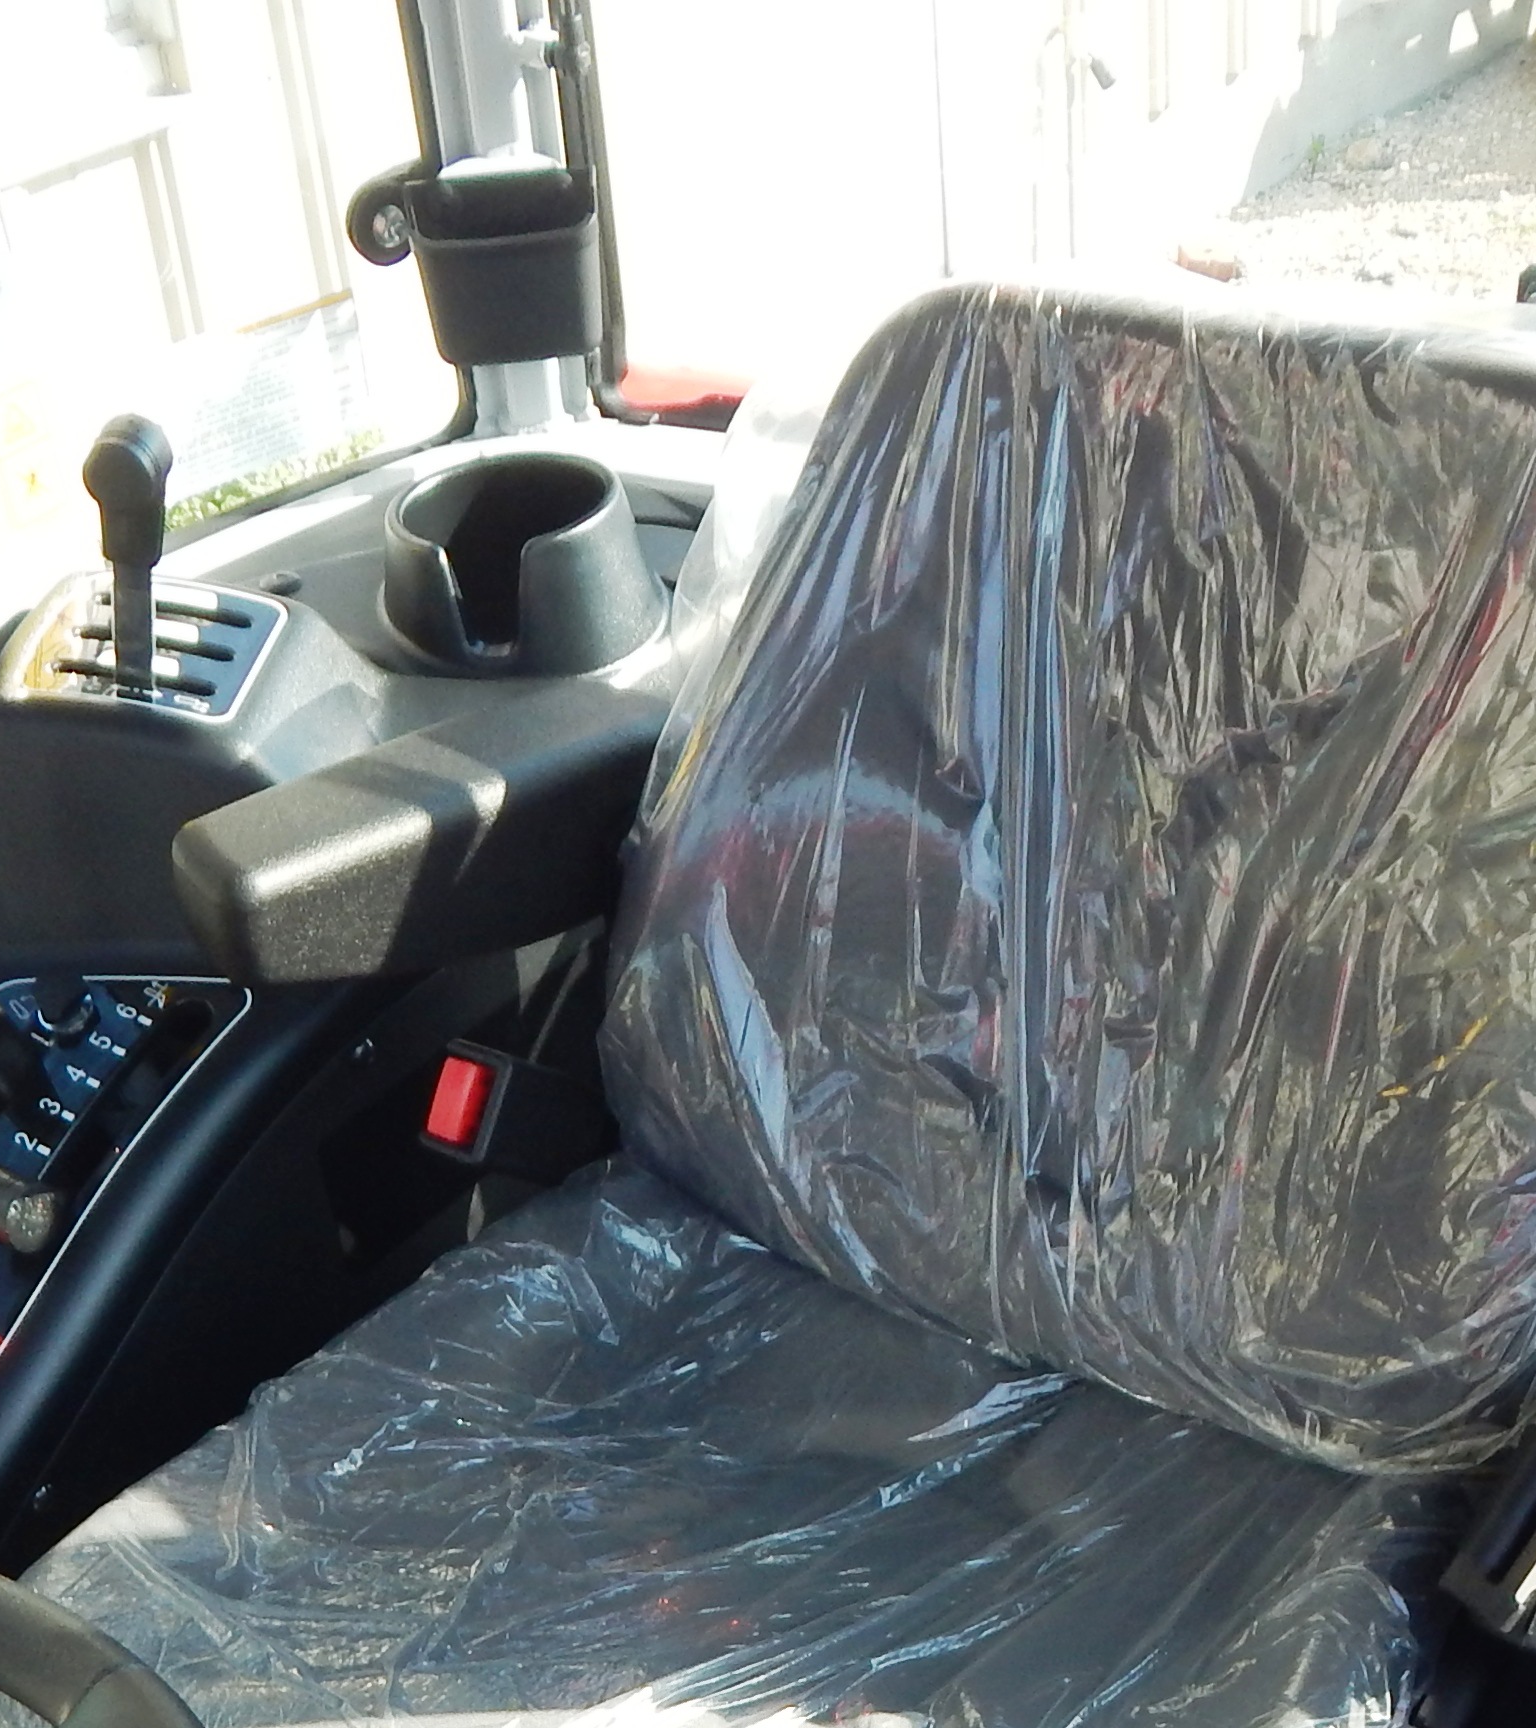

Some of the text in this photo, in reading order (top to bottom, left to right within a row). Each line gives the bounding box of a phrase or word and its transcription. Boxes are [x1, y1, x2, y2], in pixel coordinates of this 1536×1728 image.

[116, 1003, 137, 1019] 6
[89, 1031, 112, 1050] 5
[66, 1064, 86, 1082] 4
[39, 1097, 61, 1115] 3
[14, 1132, 38, 1151] 2
